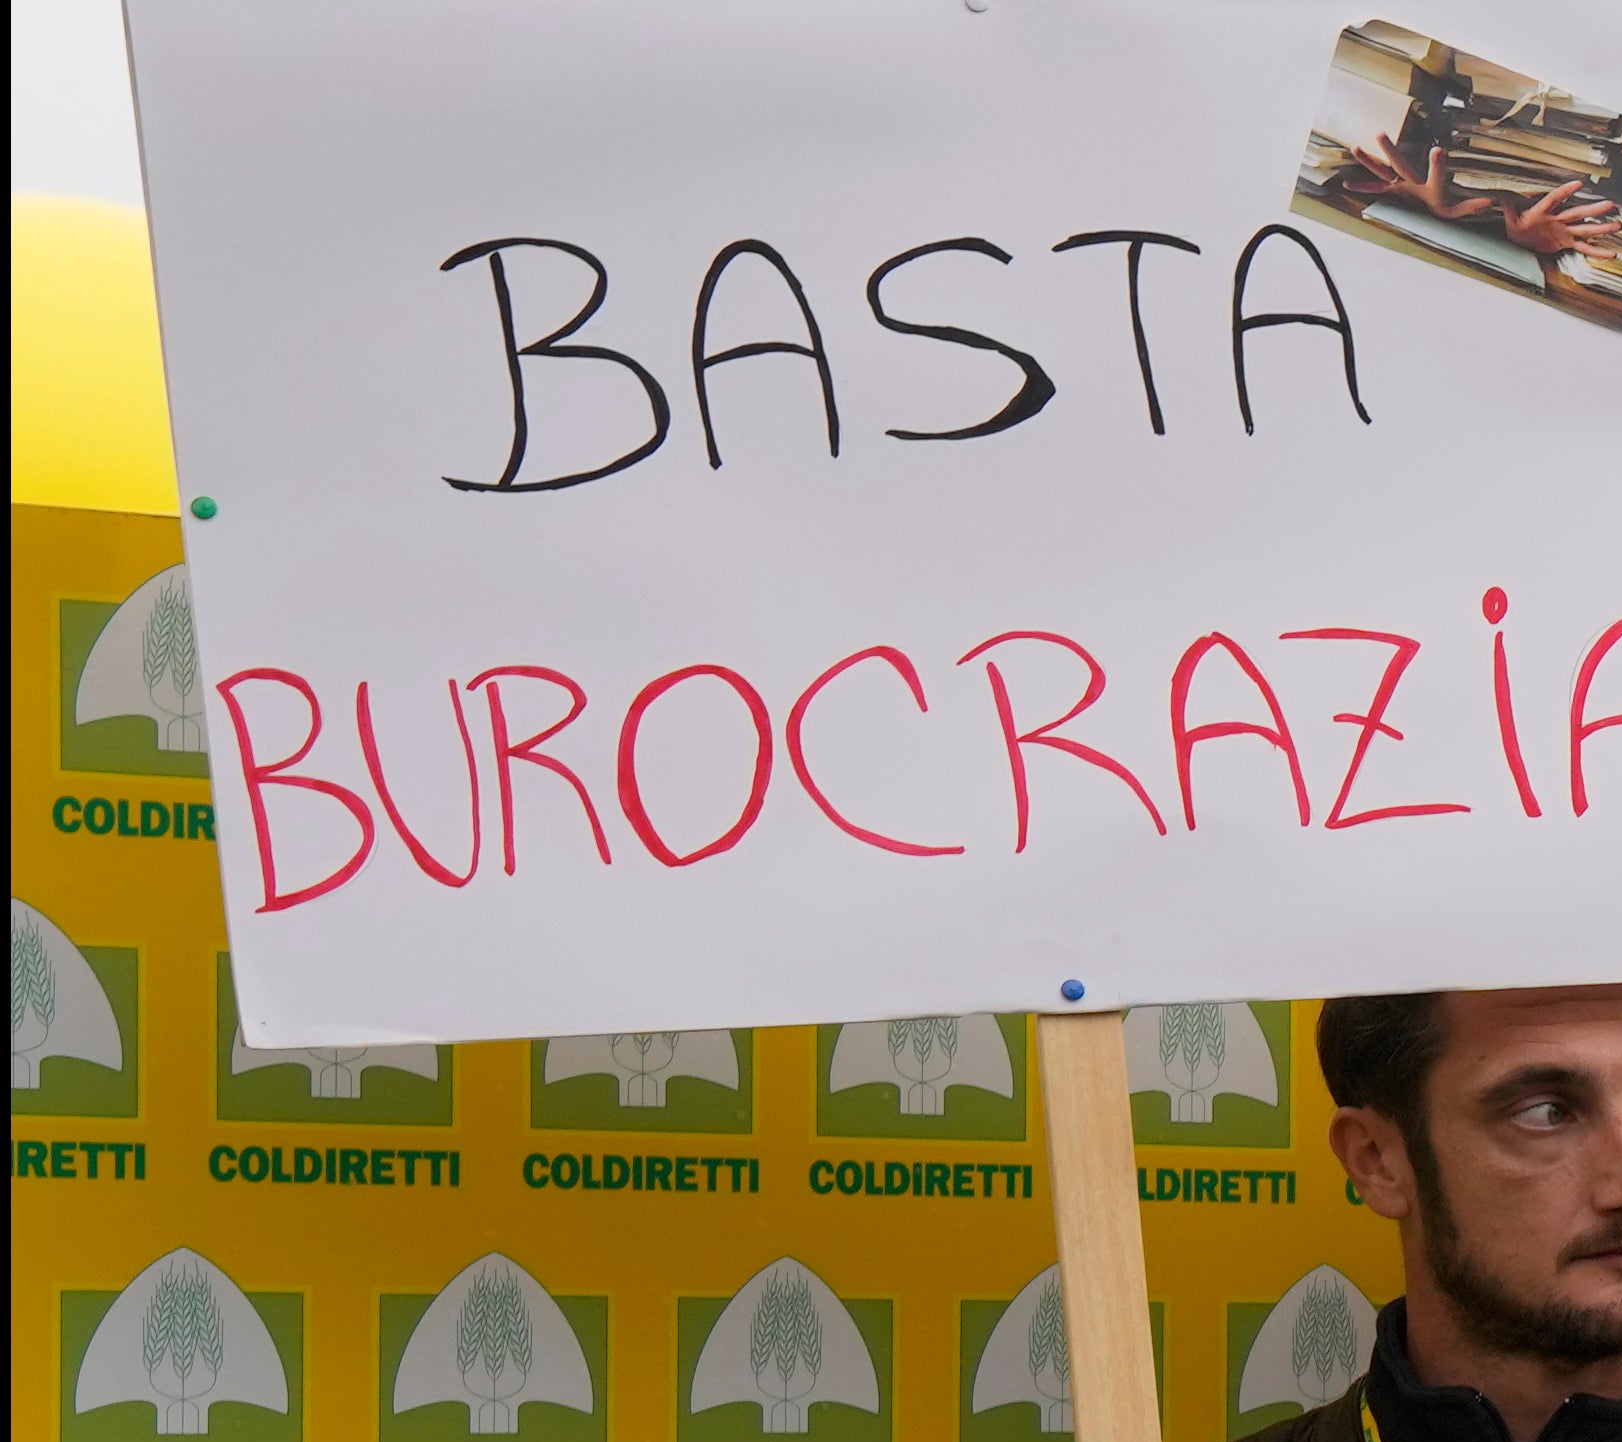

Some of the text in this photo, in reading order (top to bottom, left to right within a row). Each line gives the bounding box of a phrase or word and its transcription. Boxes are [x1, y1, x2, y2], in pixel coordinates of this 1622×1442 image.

[441, 222, 1372, 494] BASTA
[54, 798, 215, 839] COLDIR
[210, 1147, 458, 1184] COLDIRETTI
[525, 1155, 758, 1191] COLDIRETTI
[811, 1162, 1031, 1196] COLDIRETTI
[1140, 1170, 1294, 1201] LDIRETTI
